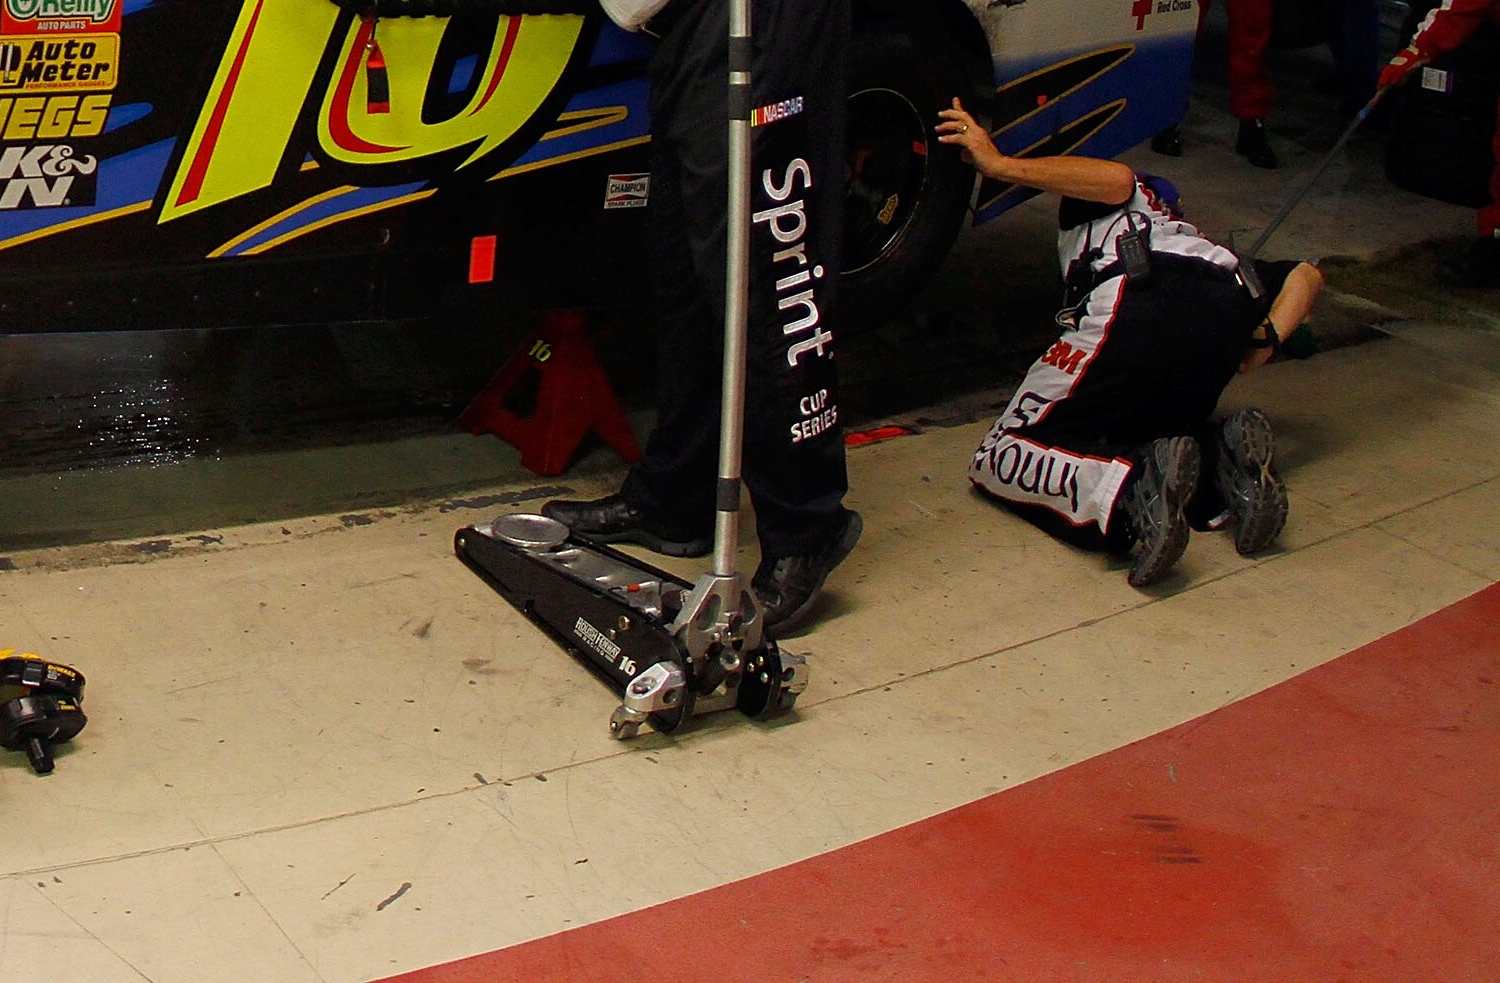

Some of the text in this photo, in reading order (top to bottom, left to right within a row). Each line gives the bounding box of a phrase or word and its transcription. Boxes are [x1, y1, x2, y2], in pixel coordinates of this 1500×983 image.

[1156, 0, 1171, 14] Red
[37, 20, 86, 31] AUTO PARTS
[25, 39, 97, 62] Auto
[21, 60, 110, 83] Meter
[762, 96, 804, 123] NASCAR
[610, 181, 646, 194] CHAMPION
[752, 158, 834, 367] Sprint
[528, 339, 554, 362] 16
[800, 387, 828, 416] CUP
[790, 403, 838, 444] SERIES
[618, 655, 637, 677] 16
